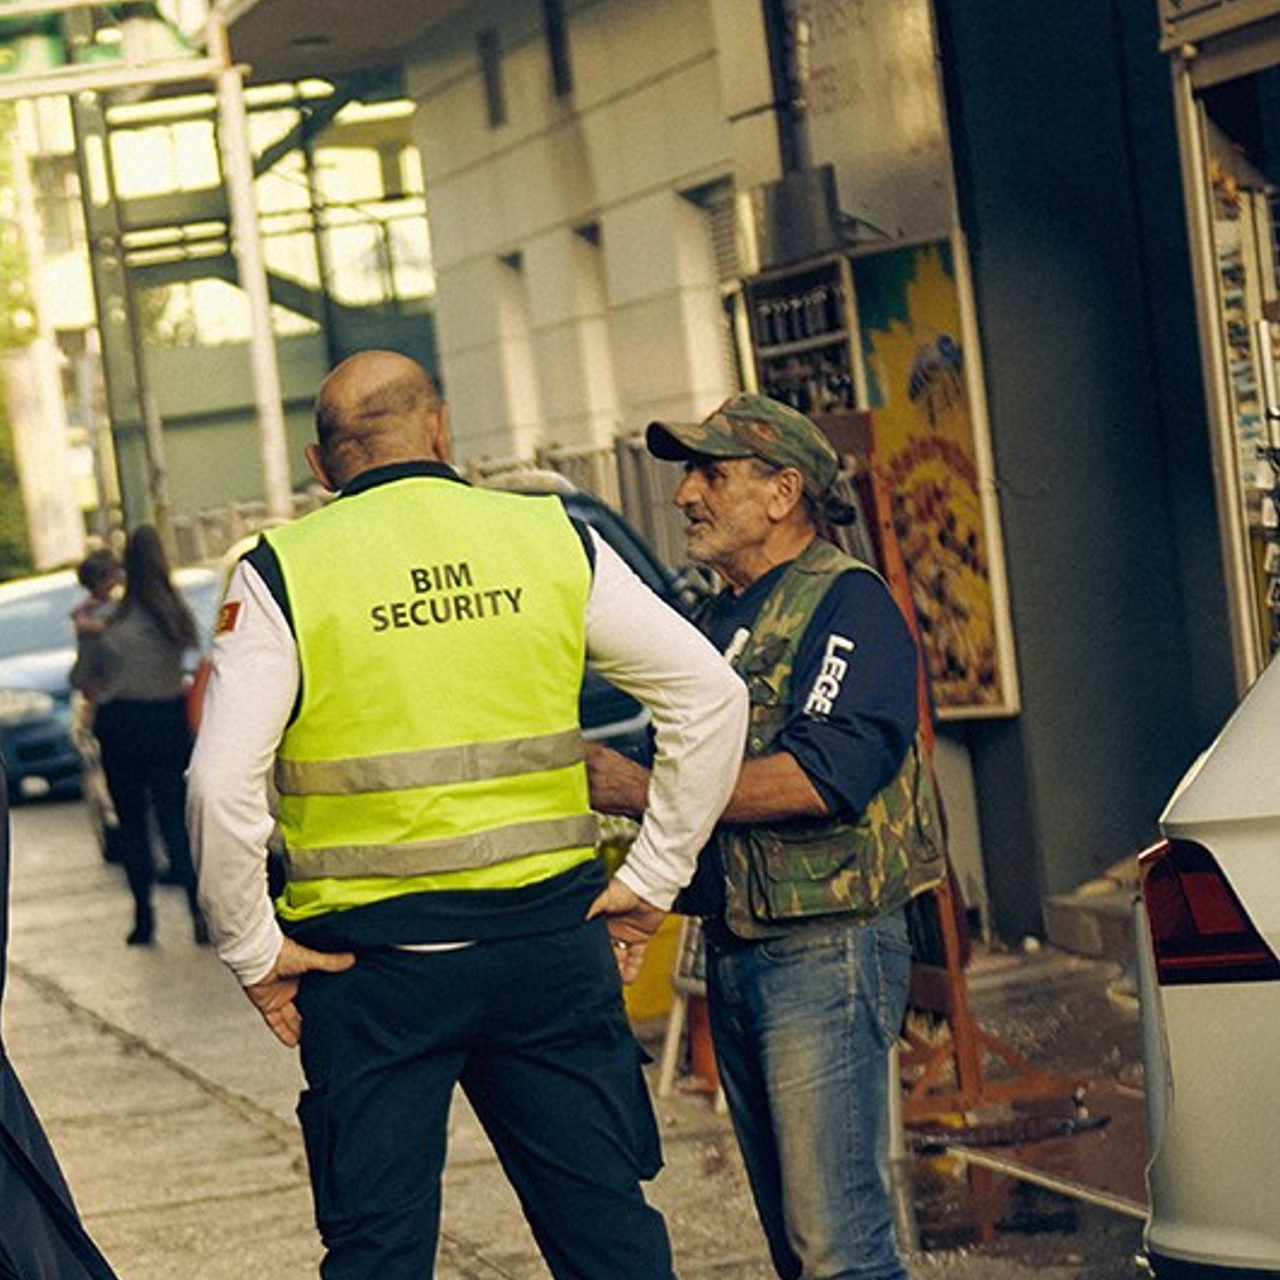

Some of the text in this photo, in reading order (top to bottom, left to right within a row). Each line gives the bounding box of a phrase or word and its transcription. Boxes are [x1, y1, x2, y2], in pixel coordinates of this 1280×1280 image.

[410, 562, 474, 595] BIM
[370, 587, 523, 633] SECURITY
[802, 633, 856, 722] LEGE
